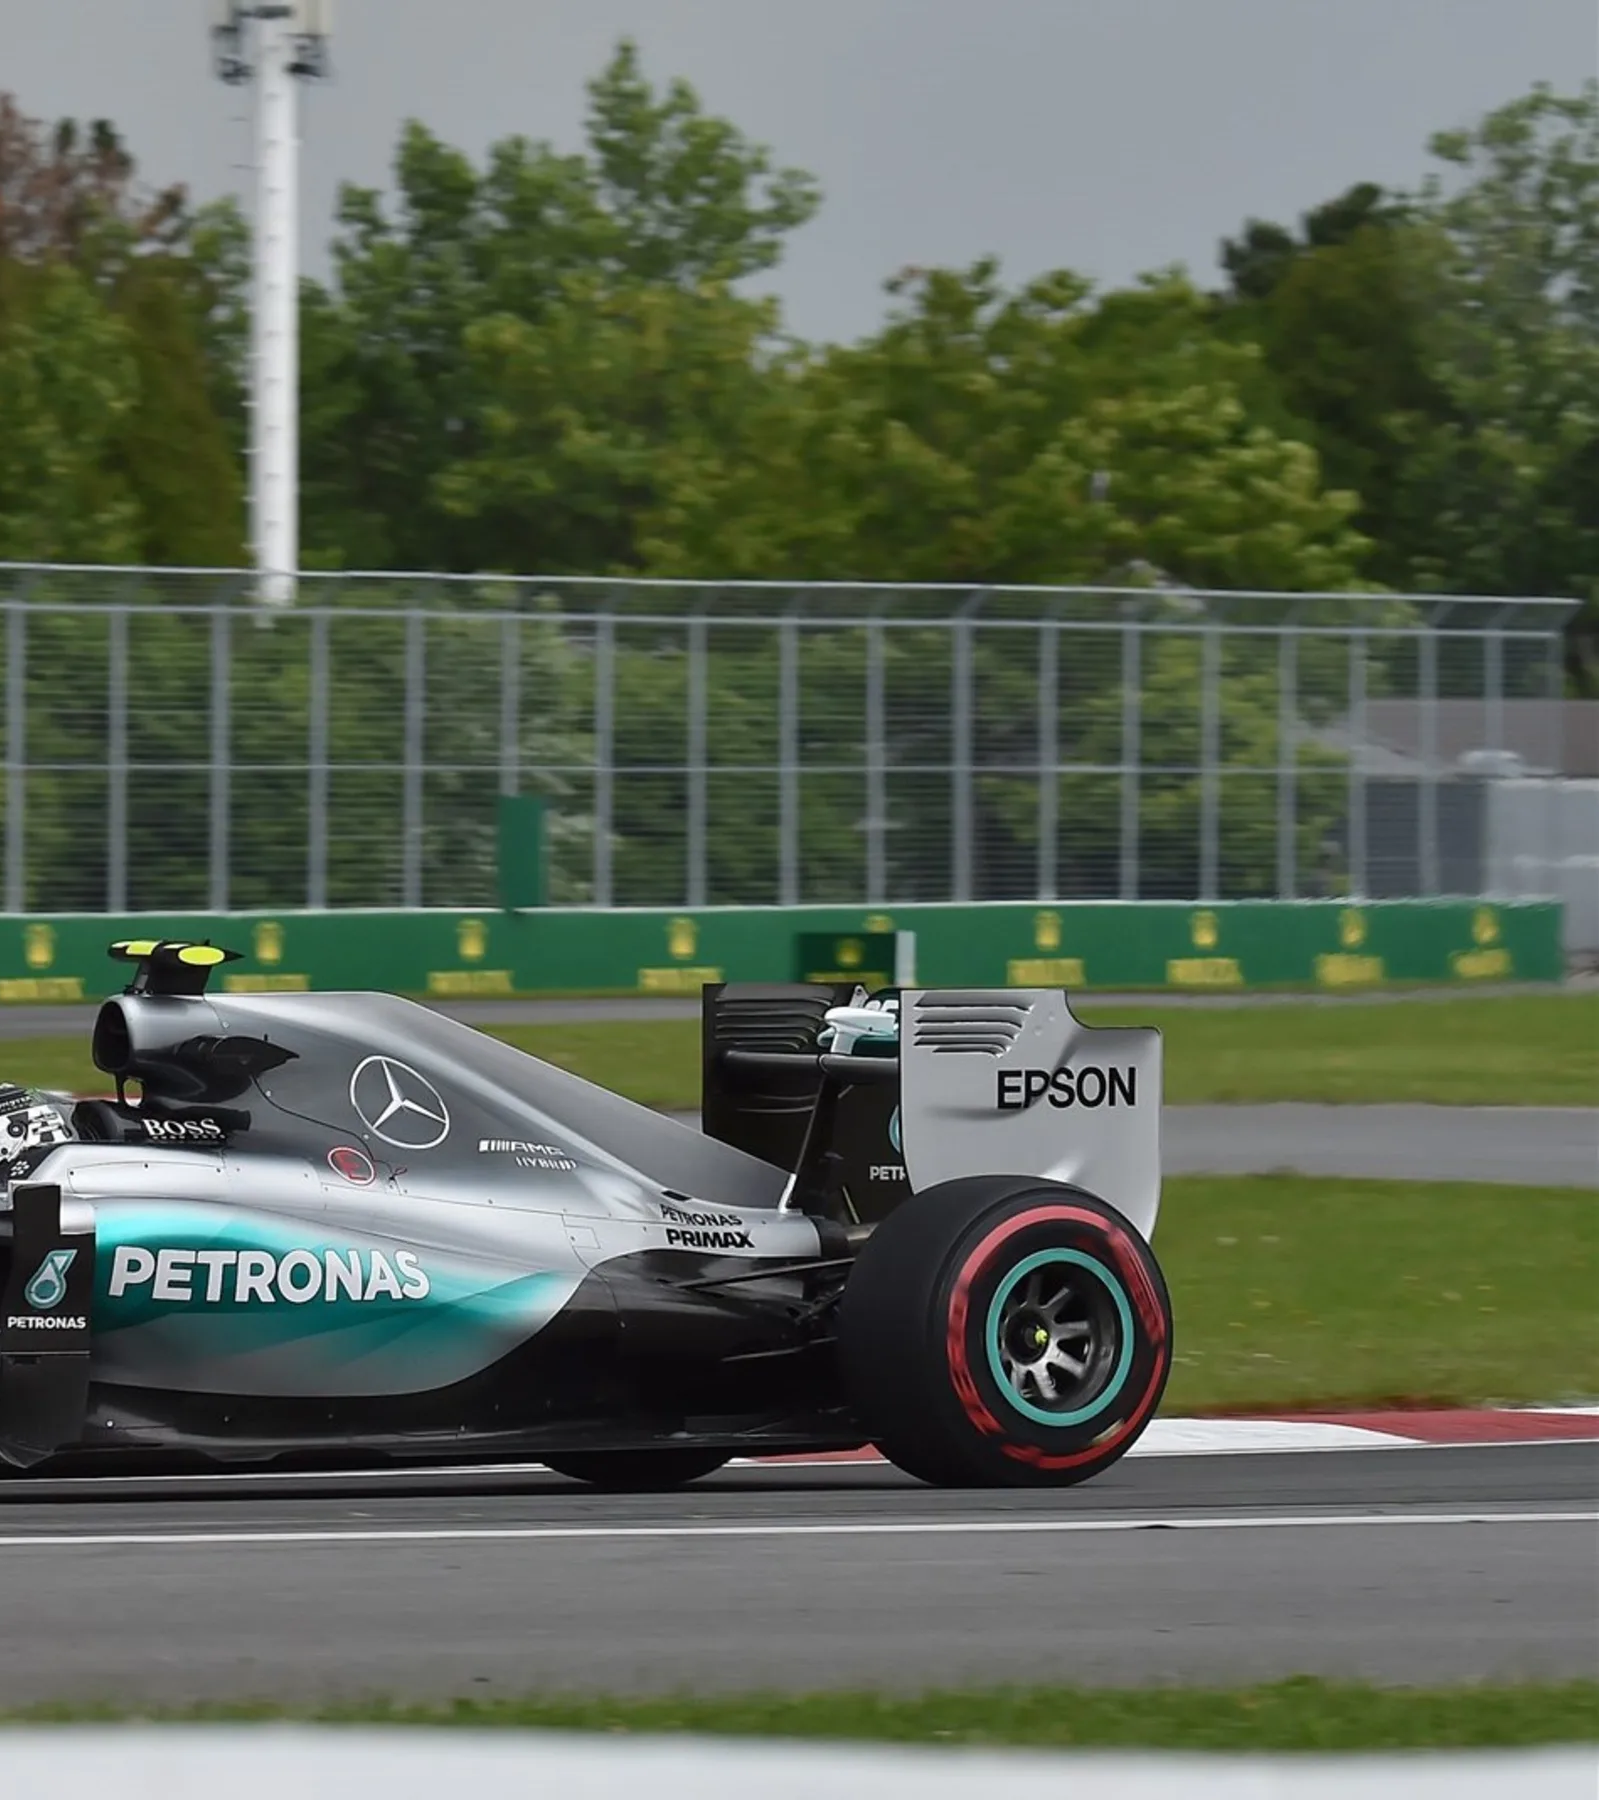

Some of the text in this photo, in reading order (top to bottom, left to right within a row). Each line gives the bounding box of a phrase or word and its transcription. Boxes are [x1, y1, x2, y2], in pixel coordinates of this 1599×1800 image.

[997, 1066, 1136, 1109] EPSON
[142, 1118, 221, 1136] BOSS
[660, 1203, 743, 1226] PETRONAS
[666, 1228, 755, 1248] PRIMAX
[107, 1245, 430, 1303] PETRONAS
[7, 1316, 86, 1329] PETRONAS
